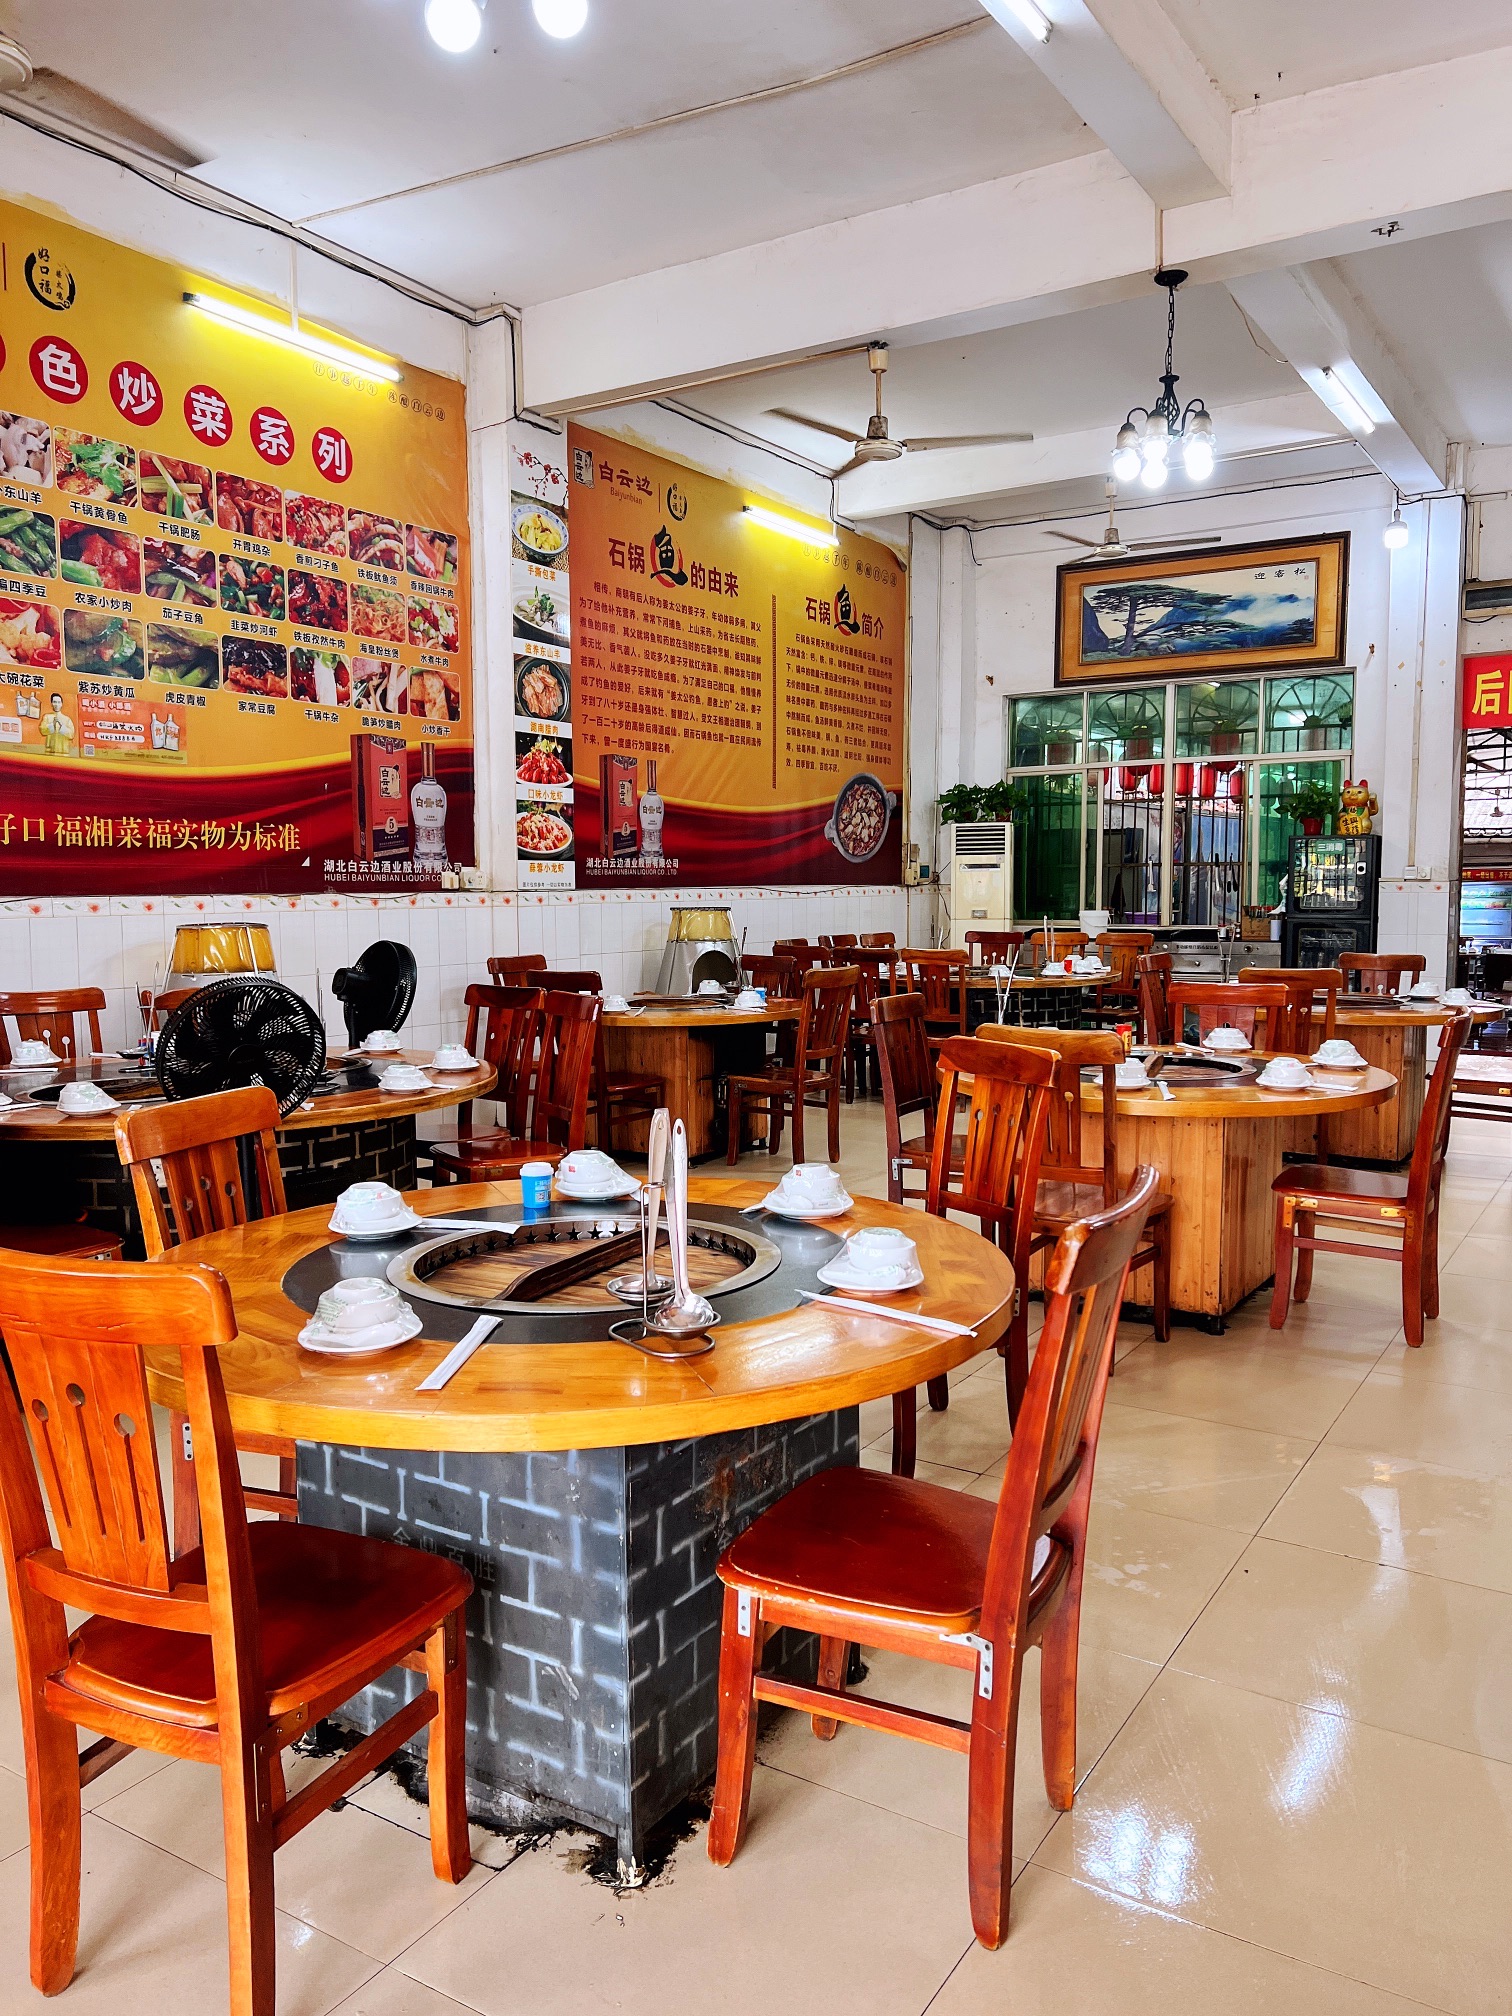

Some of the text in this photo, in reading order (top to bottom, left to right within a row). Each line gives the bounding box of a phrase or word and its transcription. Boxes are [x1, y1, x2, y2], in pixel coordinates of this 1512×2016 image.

[37, 246, 52, 295] 好口福
[599, 460, 653, 497] 白云边
[0, 485, 42, 504] 东山羊
[610, 486, 643, 505] Baiyunbian
[70, 500, 129, 526] 干锅黄骨鱼
[158, 521, 201, 542] 干锅肥肠
[232, 537, 271, 557] 开胃鸡杂
[295, 553, 340, 573] 香煎刁子鱼
[357, 567, 398, 587] 铁板鱿鱼须
[1254, 567, 1306, 579] 迎客松
[410, 580, 454, 599] 香辣回锅牛肉
[75, 592, 132, 613] 农家小炒肉
[805, 584, 884, 640] 石锅鱼简介
[162, 606, 204, 625] 茄子豆角
[231, 619, 277, 637] 韭菜炒河虾
[293, 630, 346, 650] 铁板孜然牛肉
[359, 642, 399, 659] 海皇粉丝煲
[420, 653, 449, 668] 水煮牛肉
[78, 681, 135, 698] 紫苏炒黄瓜
[165, 692, 206, 706] 虎皮青椒
[1472, 669, 1512, 716] 后
[238, 701, 276, 715] 家常豆腐
[305, 709, 339, 723] 干锅牛杂
[422, 725, 451, 737] 小炒香干
[381, 768, 391, 796] 白云边
[528, 788, 563, 801] 口味小龙虾
[324, 859, 462, 873] 湖北白云边酒业股份有限公司
[324, 873, 350, 882] HUBEI
[351, 873, 400, 882] BAIYUNBIAN
[401, 873, 430, 882] LIQUOR
